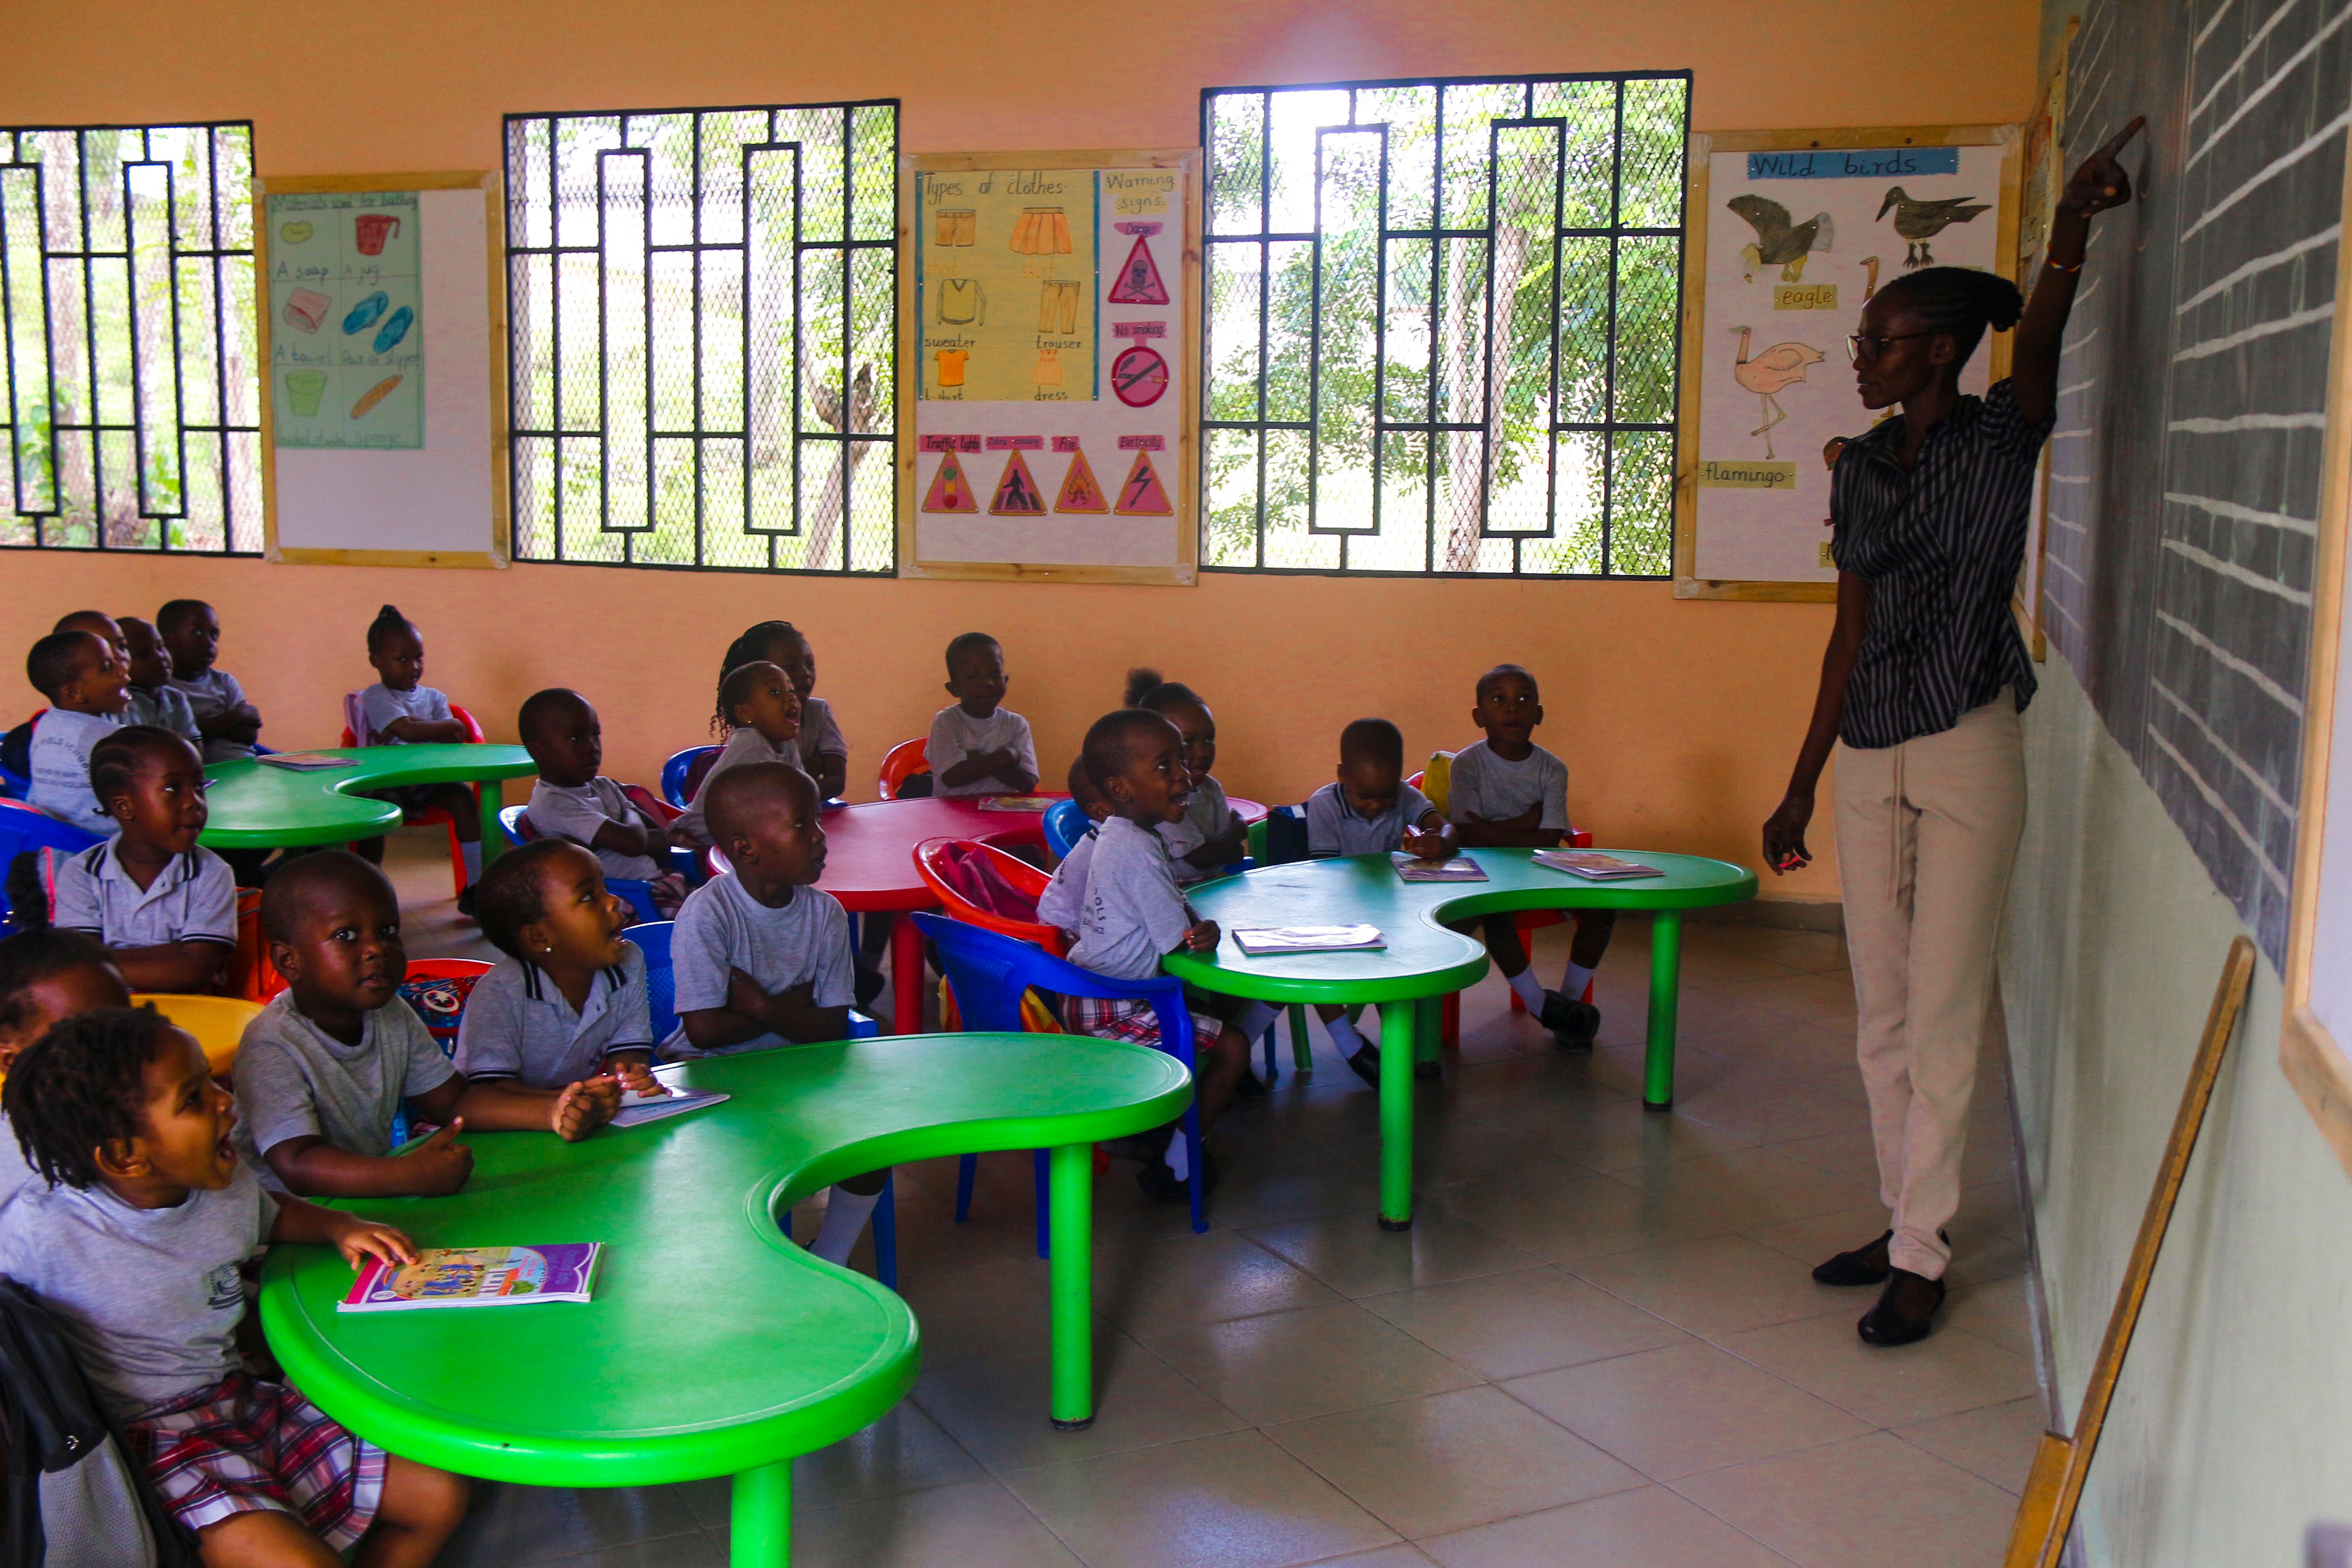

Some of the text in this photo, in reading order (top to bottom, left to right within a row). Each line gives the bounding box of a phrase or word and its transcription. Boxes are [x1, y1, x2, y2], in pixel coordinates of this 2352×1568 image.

[1754, 150, 1917, 176] Wild birds
[924, 172, 964, 205] Types
[979, 171, 996, 195] of
[1106, 174, 1174, 192] Warning
[276, 260, 329, 287] A soap
[1782, 284, 1832, 310] eagle
[1115, 324, 1128, 336] No
[924, 332, 976, 348] sweater
[1036, 335, 1082, 349] trouser
[1034, 387, 1068, 402] dress
[926, 435, 956, 452] Traffic
[1059, 436, 1077, 451] Fire
[1705, 461, 1785, 488] flamingo
